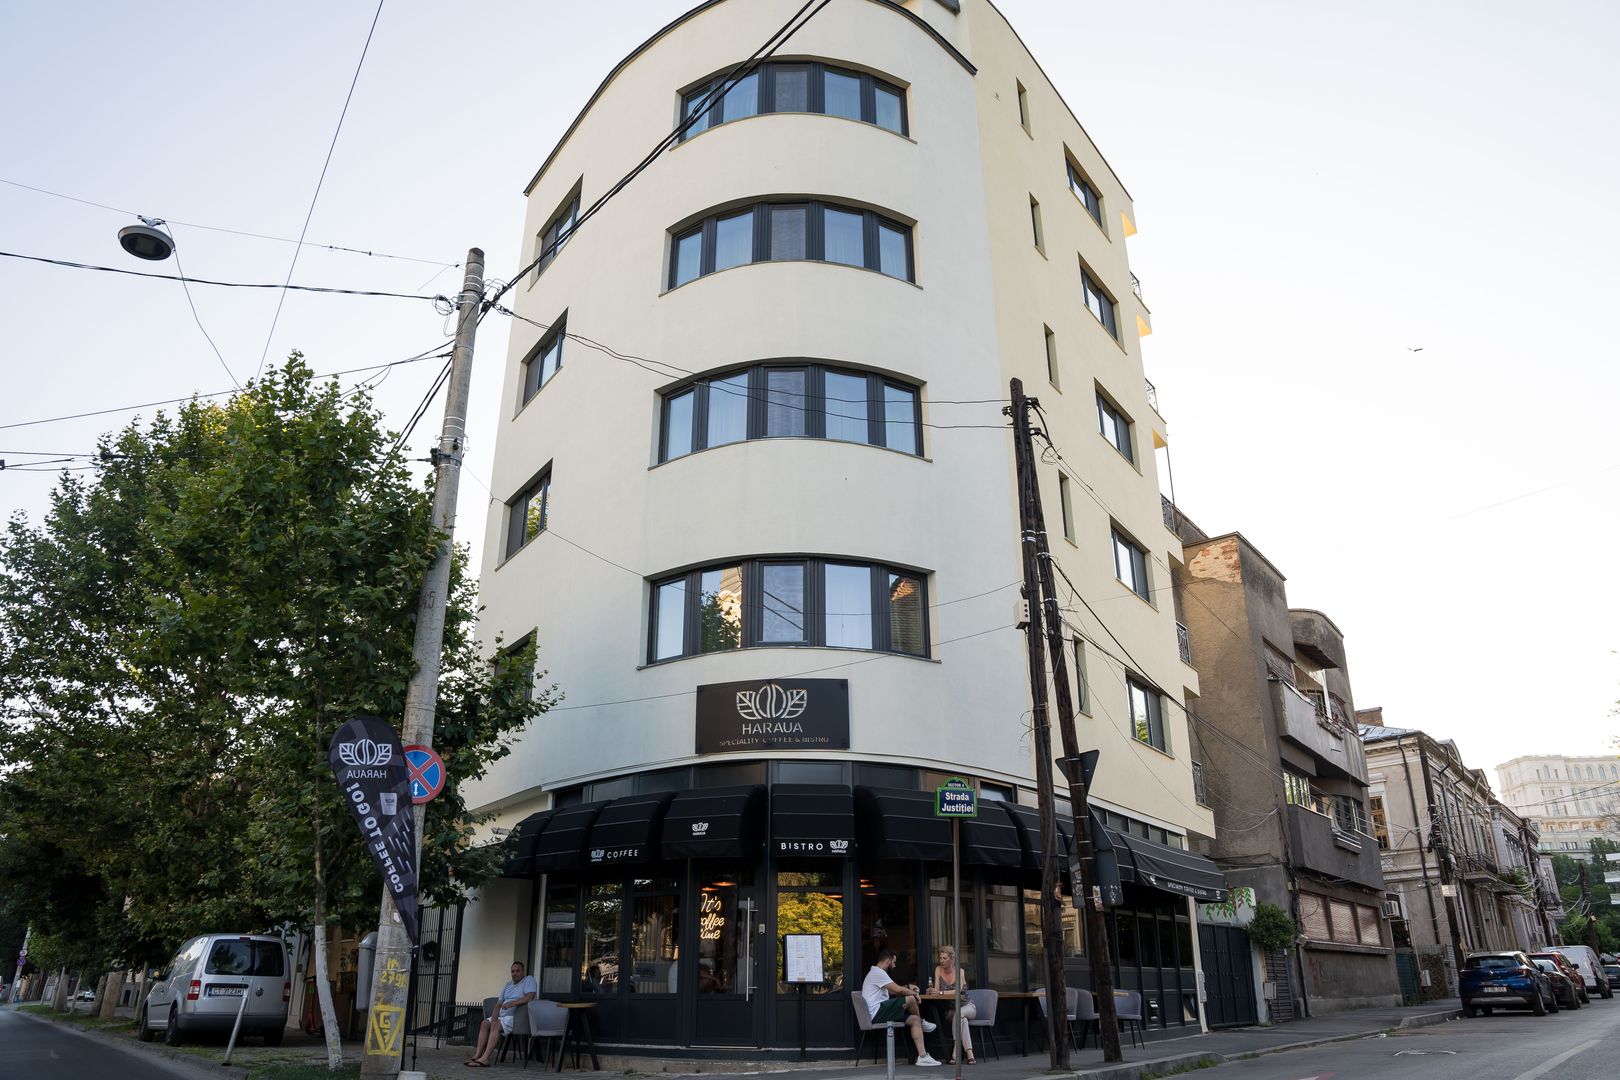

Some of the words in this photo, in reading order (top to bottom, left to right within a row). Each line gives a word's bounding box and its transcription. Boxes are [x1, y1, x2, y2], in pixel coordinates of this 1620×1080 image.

[742, 722, 803, 735] HARAUA
[945, 792, 970, 801] Strada
[780, 842, 824, 851] BISTRO
[606, 849, 639, 859] COFFEE
[700, 893, 722, 913] It's
[700, 913, 725, 931] offee
[700, 929, 721, 940] ime
